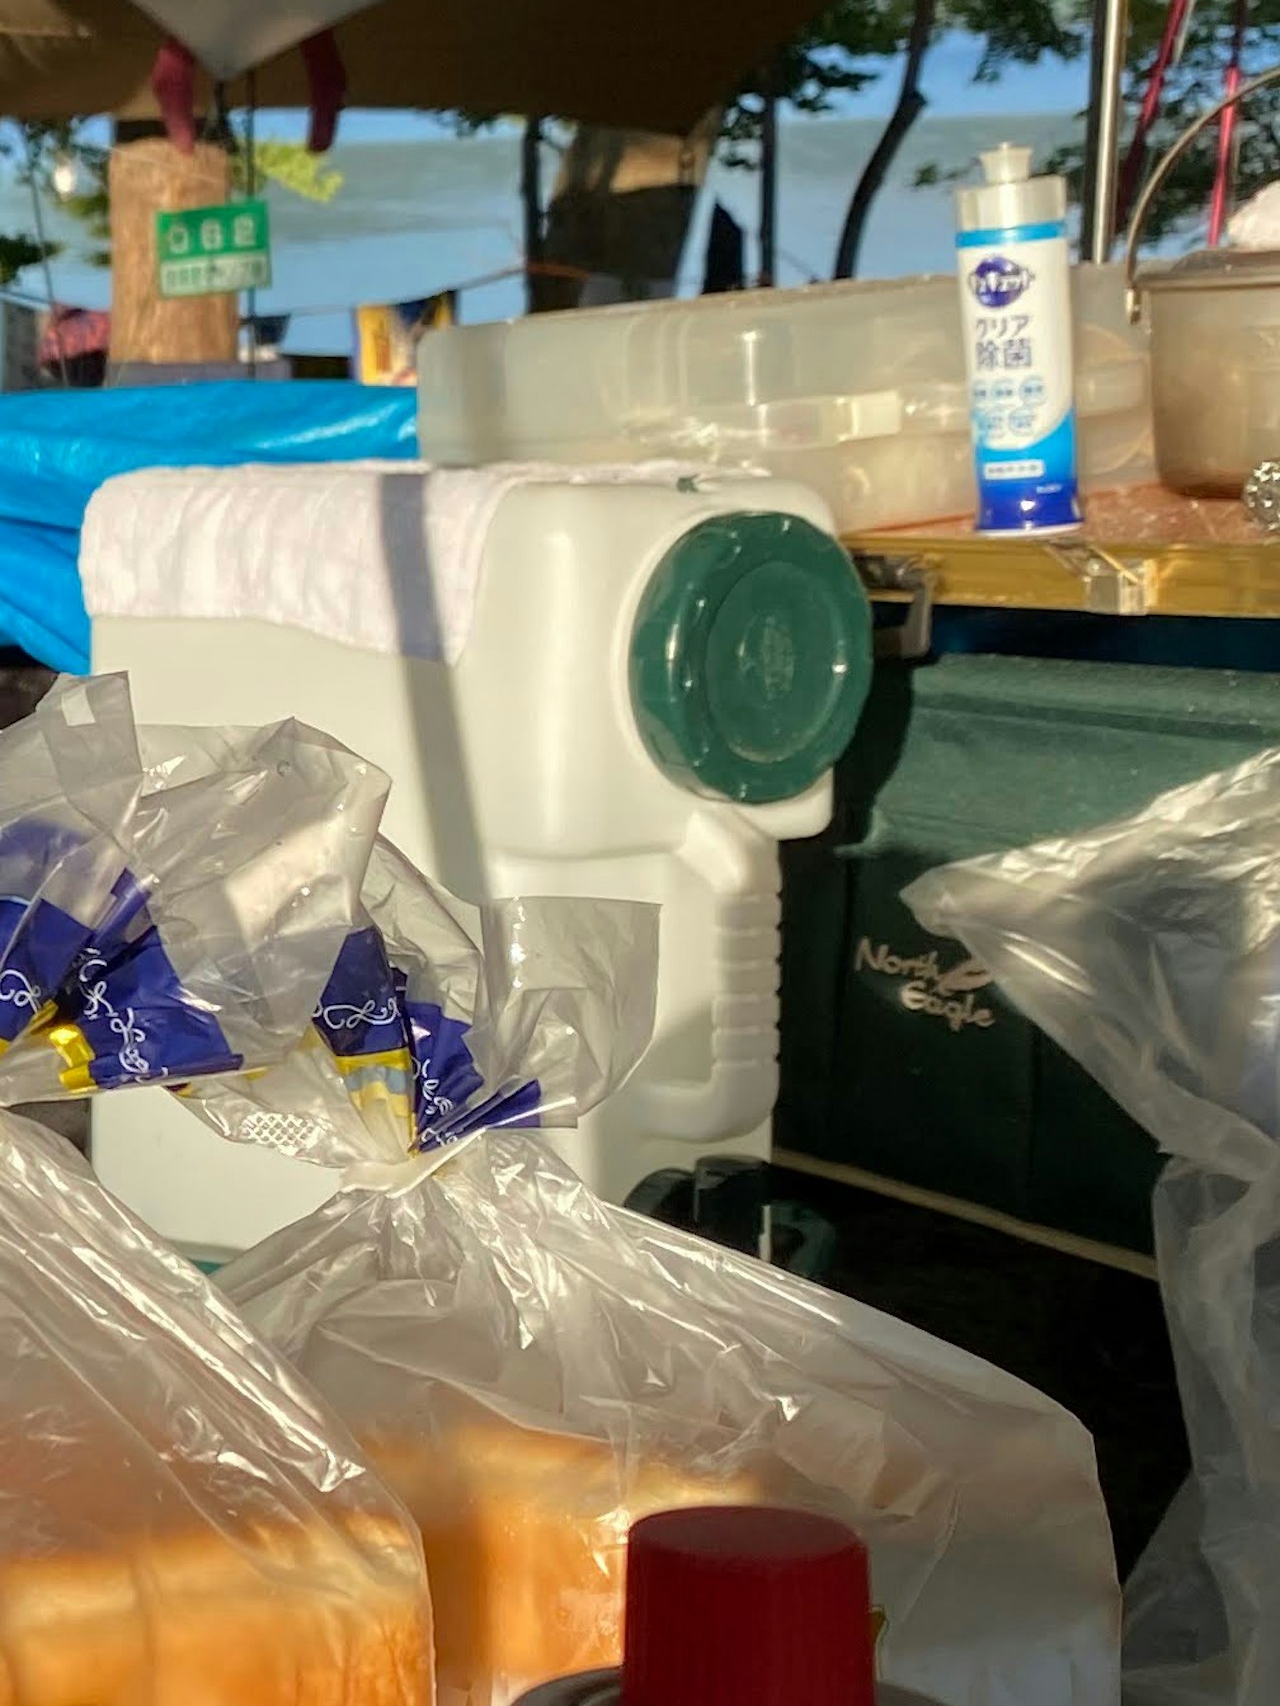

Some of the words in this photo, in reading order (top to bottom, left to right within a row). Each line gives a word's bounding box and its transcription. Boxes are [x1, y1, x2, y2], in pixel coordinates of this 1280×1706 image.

[975, 313, 1031, 340] クリア
[974, 337, 1033, 372] 除菌
[901, 979, 996, 1032] Eagle
